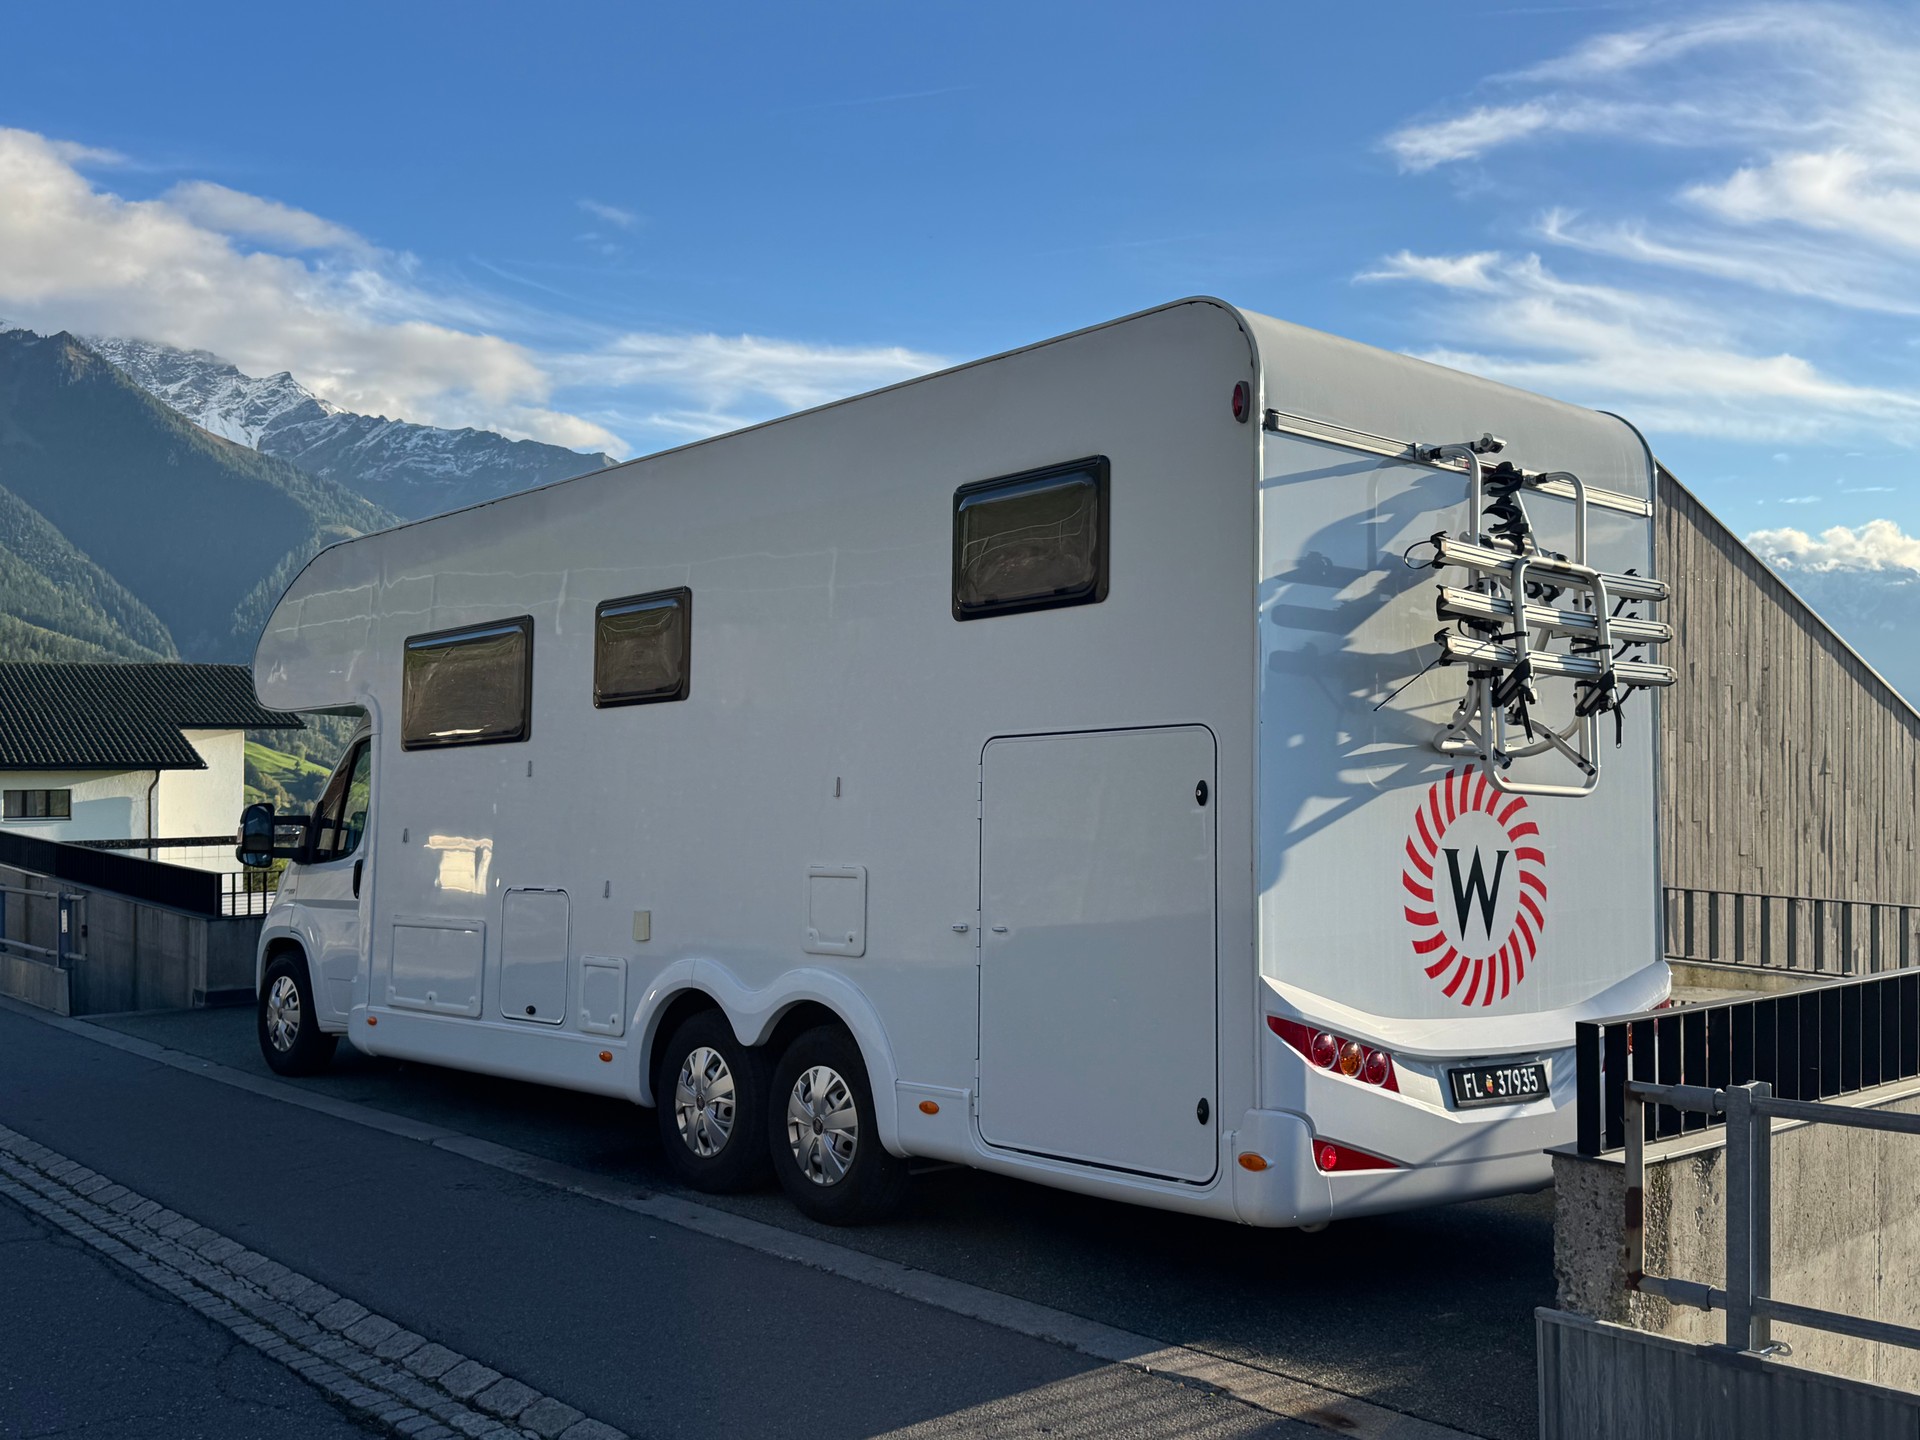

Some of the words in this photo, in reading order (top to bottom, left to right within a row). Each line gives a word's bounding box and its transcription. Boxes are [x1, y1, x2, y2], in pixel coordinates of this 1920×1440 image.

[1442, 845, 1509, 941] W
[1463, 1072, 1484, 1098] FL
[1496, 1067, 1538, 1095] 37935
